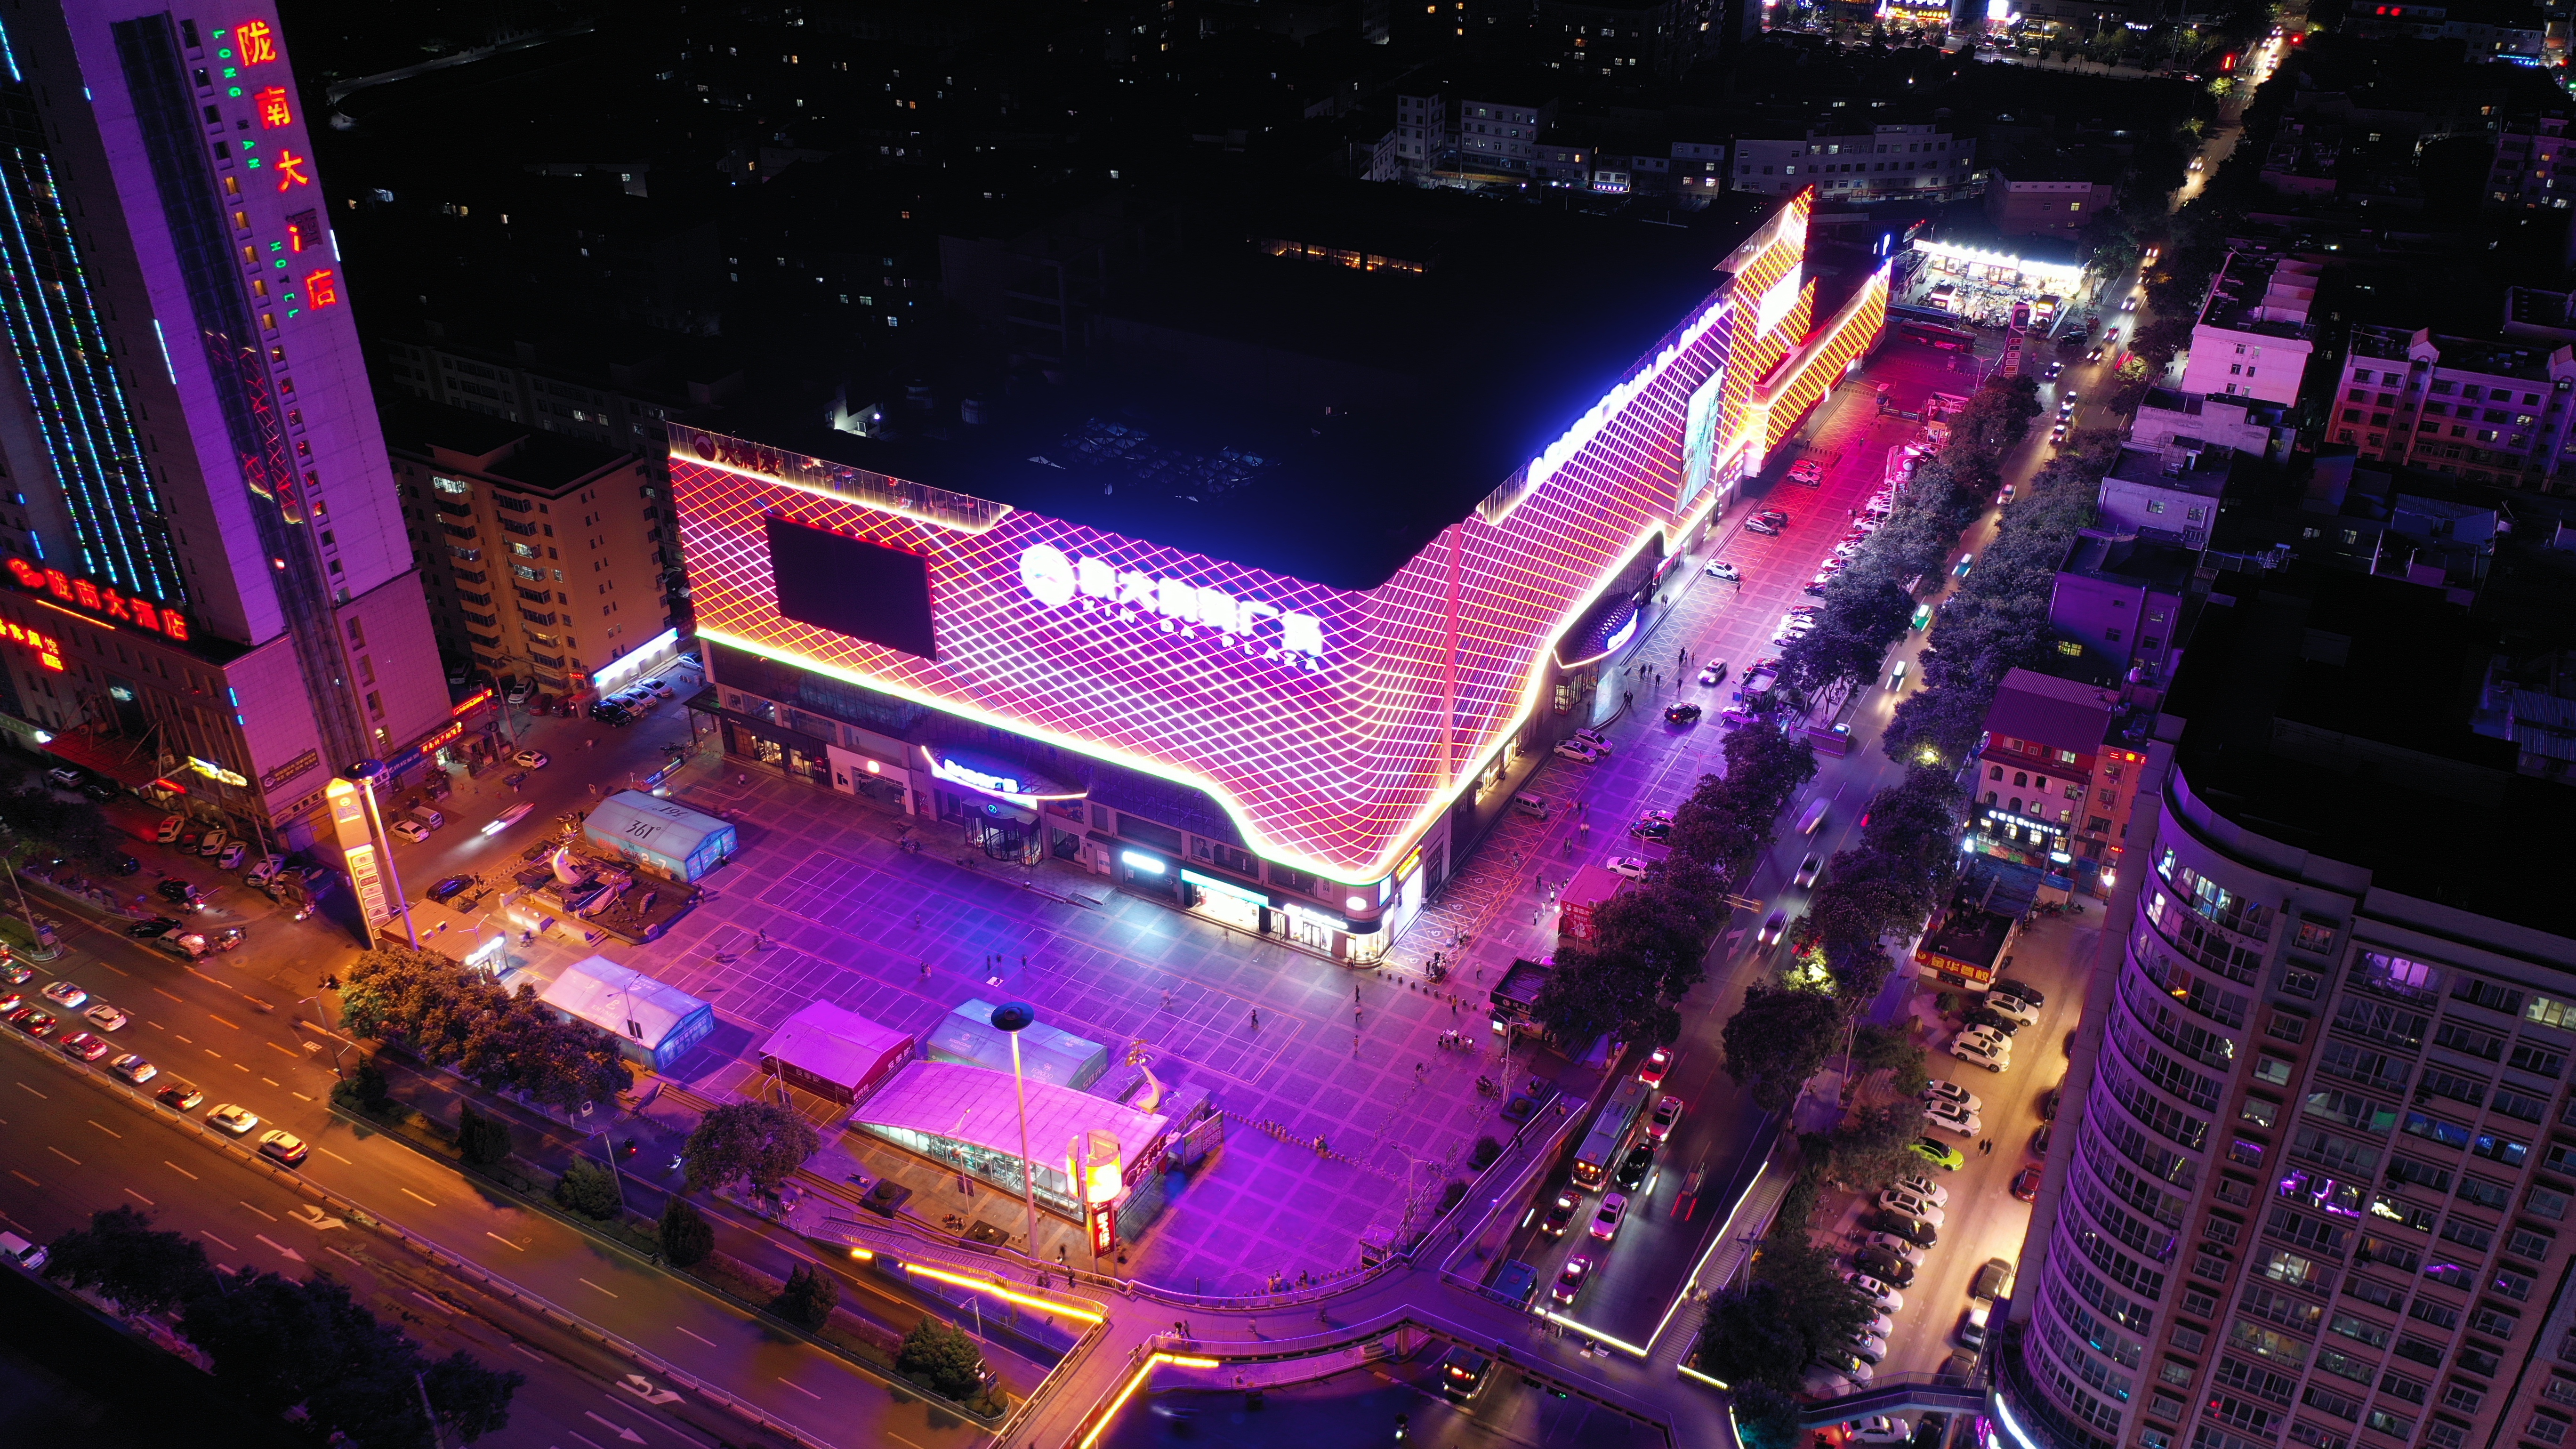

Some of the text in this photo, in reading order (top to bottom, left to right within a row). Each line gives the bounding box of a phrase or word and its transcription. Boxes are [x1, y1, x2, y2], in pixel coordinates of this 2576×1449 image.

[213, 29, 298, 318] LONG NAN HOTEL
[236, 21, 337, 310] 陇南大酒店
[718, 441, 781, 478] 大润发
[45, 569, 189, 641] 陇南大酒店
[1081, 599, 1320, 671] XIN DA PLAZA
[625, 819, 661, 839] 361°
[1931, 956, 1989, 982] 金华驾校
